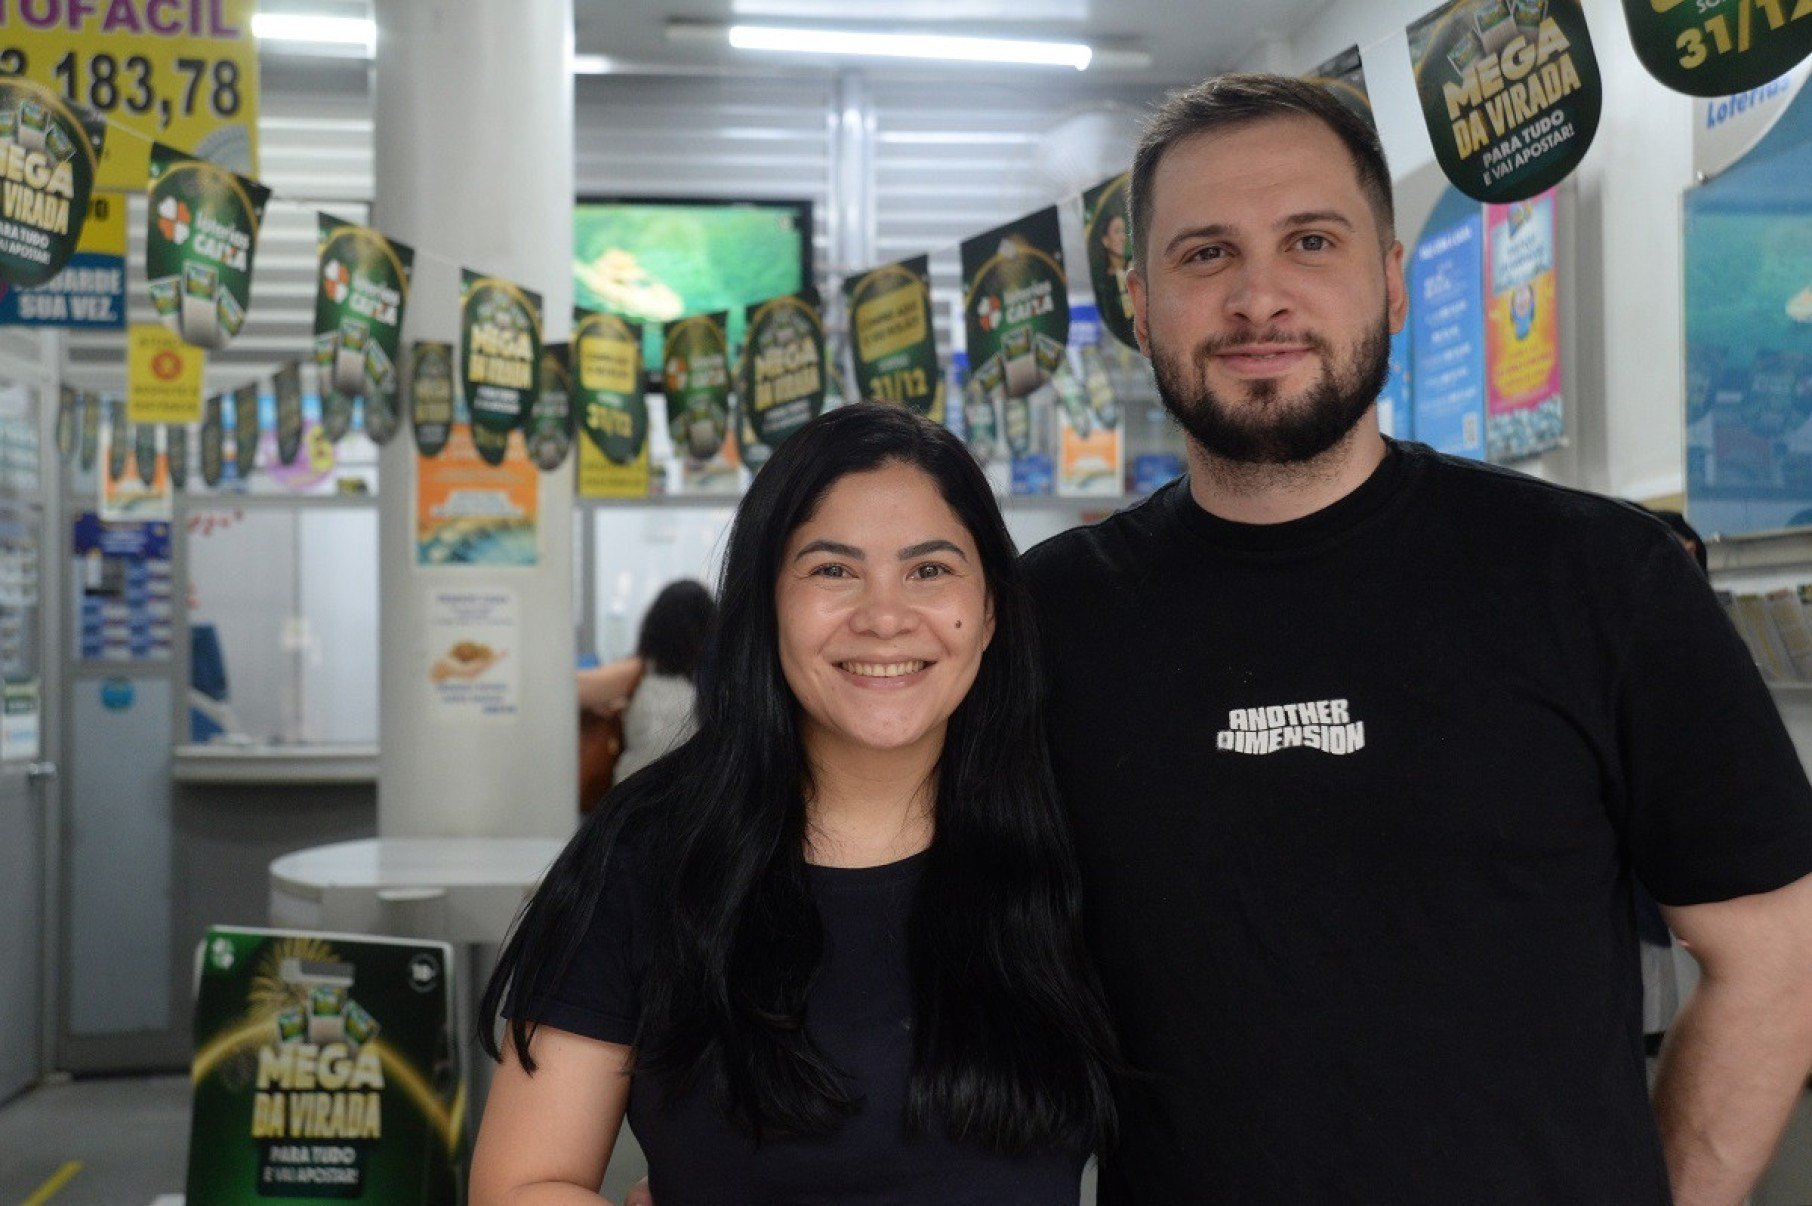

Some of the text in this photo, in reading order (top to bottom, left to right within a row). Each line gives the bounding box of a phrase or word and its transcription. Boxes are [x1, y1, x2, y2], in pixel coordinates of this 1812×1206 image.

[1442, 16, 1570, 122] MEGA
[1452, 52, 1582, 160] DA VIRADA
[1482, 109, 1565, 168] PARA TUDO
[1490, 159, 1513, 181] VAI
[1515, 122, 1575, 169] APOSTAR!
[1215, 720, 1366, 756] DIMENSION
[1229, 699, 1350, 731] ANOTHER
[256, 1042, 385, 1091] MEGA
[252, 1091, 382, 1139] DA VIRADA
